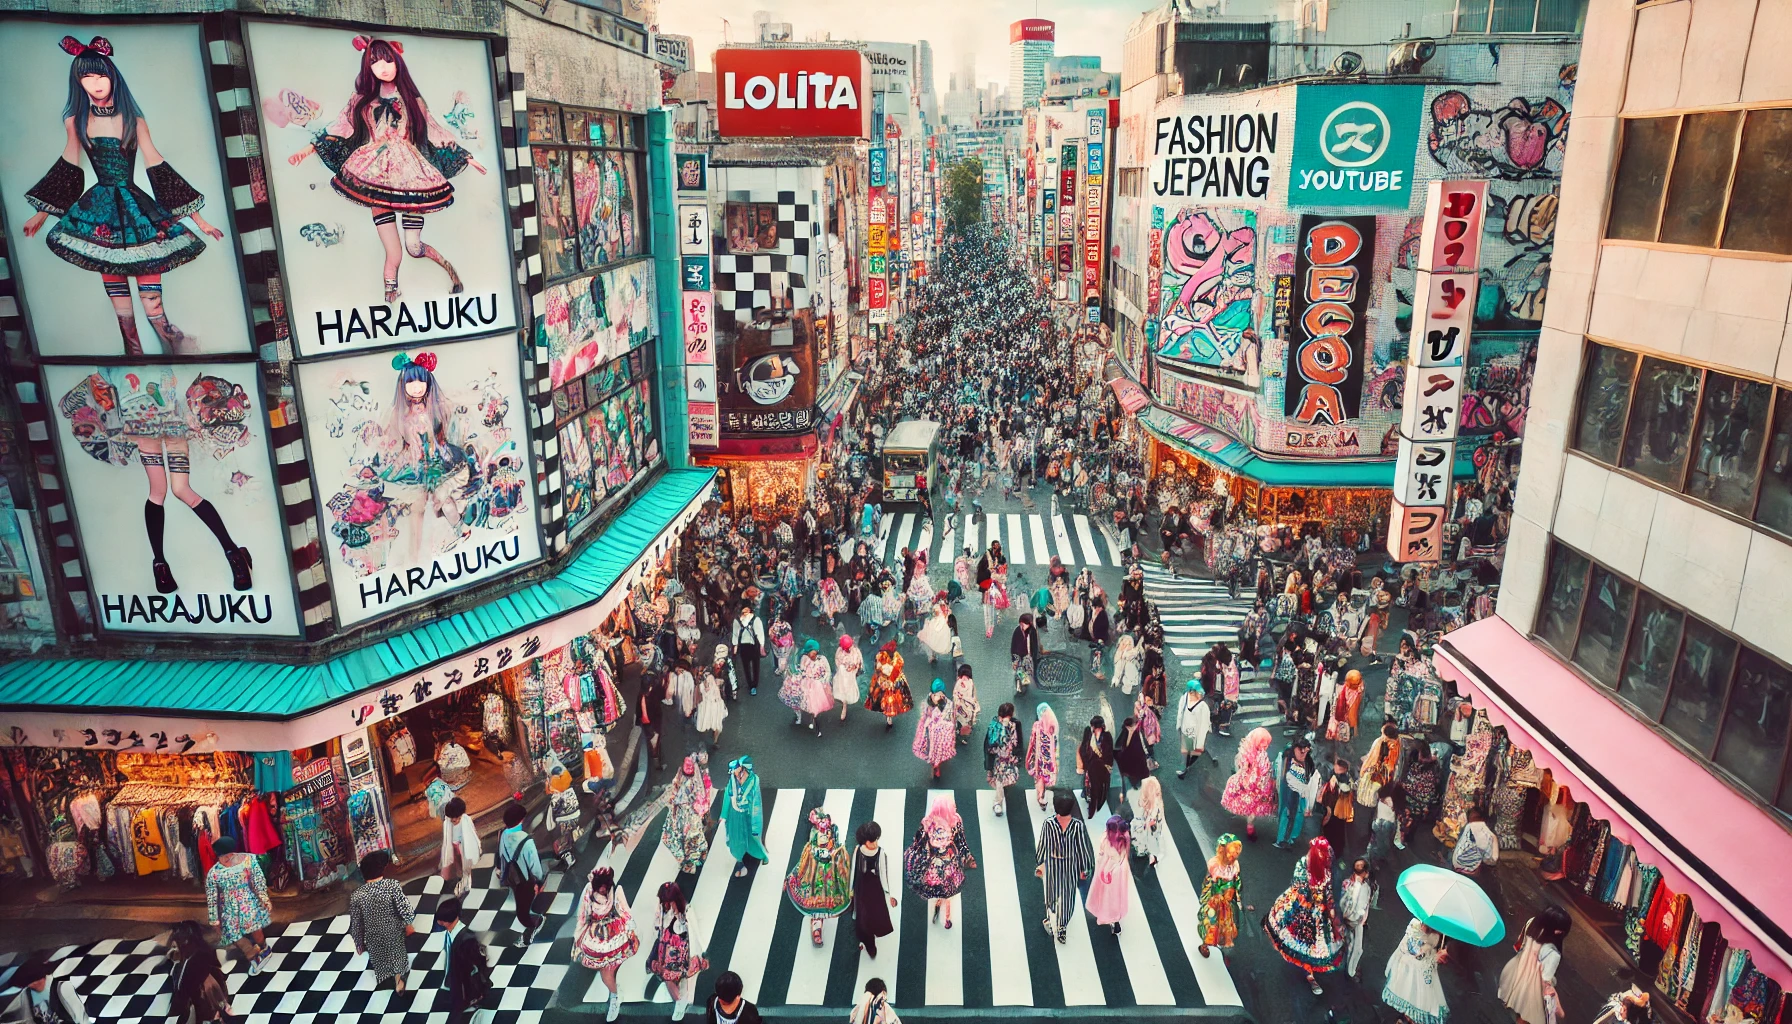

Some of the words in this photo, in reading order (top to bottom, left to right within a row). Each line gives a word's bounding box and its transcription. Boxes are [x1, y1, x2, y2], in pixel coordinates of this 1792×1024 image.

[1155, 112, 1278, 155] FASHION
[1154, 156, 1270, 199] JEPANG
[1298, 169, 1403, 192] YOUTUBE
[316, 293, 498, 345] HARAJUKU
[360, 535, 520, 608] HARAJUKU
[102, 594, 273, 625] HARAJUKU
